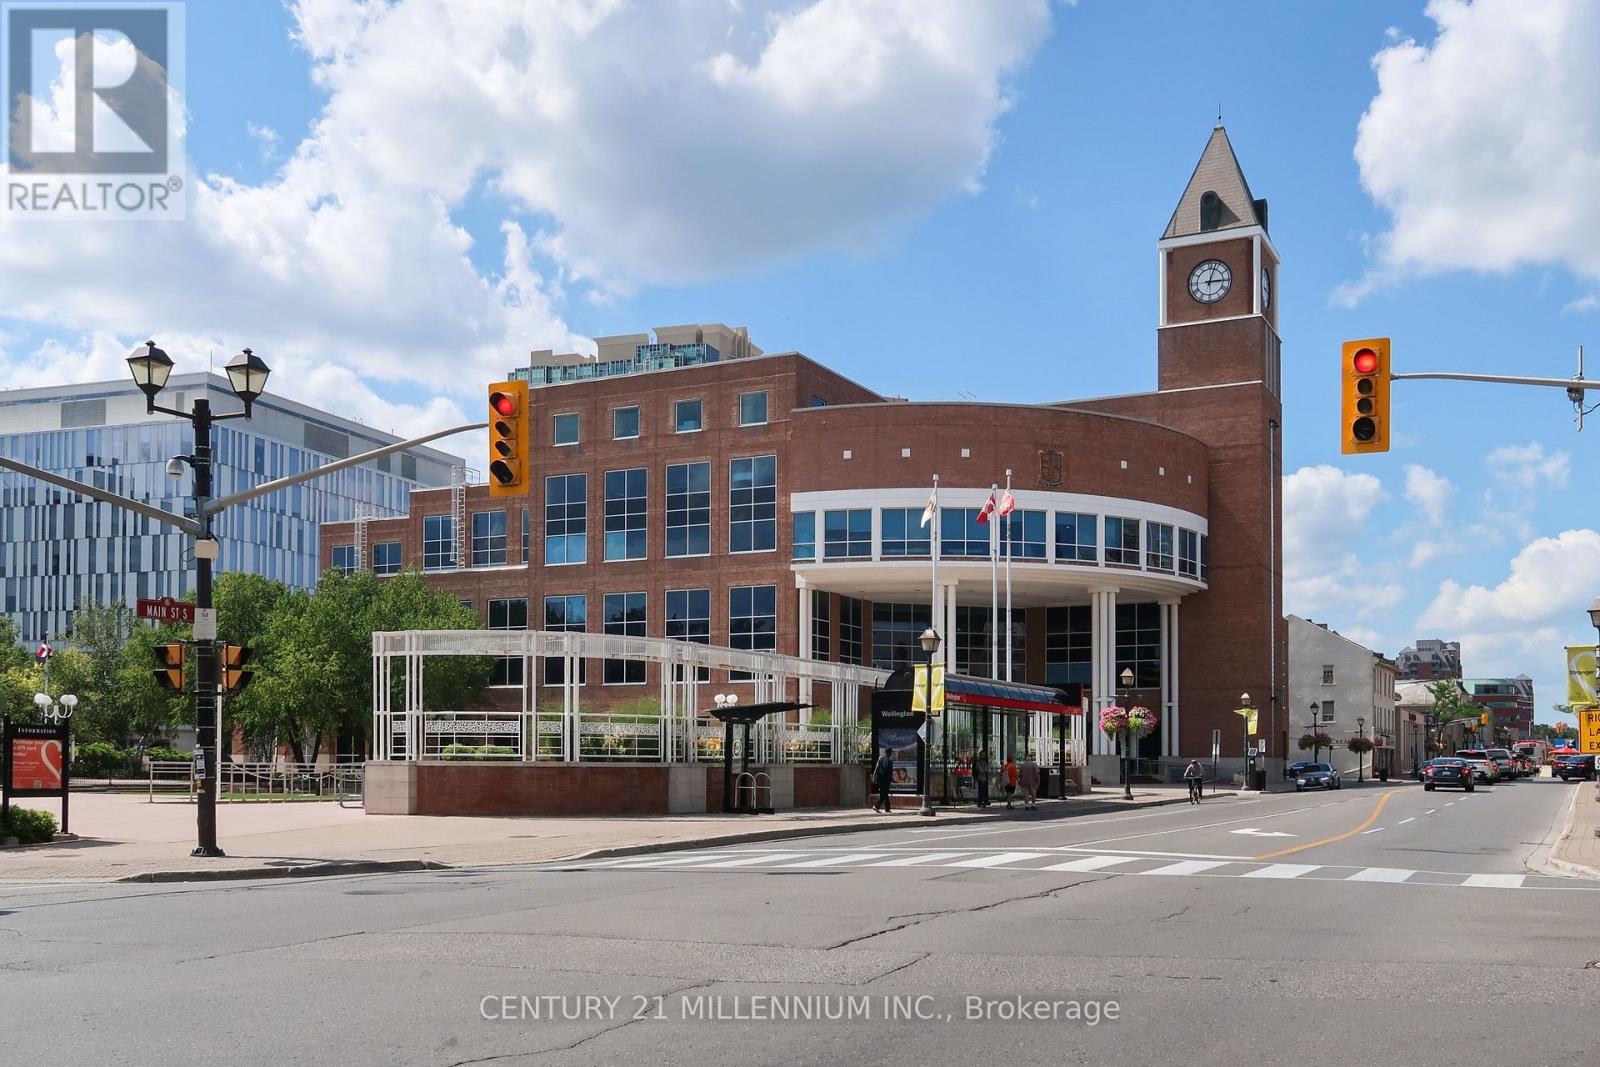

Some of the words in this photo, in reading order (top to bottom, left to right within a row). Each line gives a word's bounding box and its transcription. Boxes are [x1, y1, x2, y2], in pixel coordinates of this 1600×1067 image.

[146, 605, 167, 618] MAIN
[170, 607, 180, 619] ST
[182, 608, 188, 620] S
[881, 710, 914, 718] Wellington
